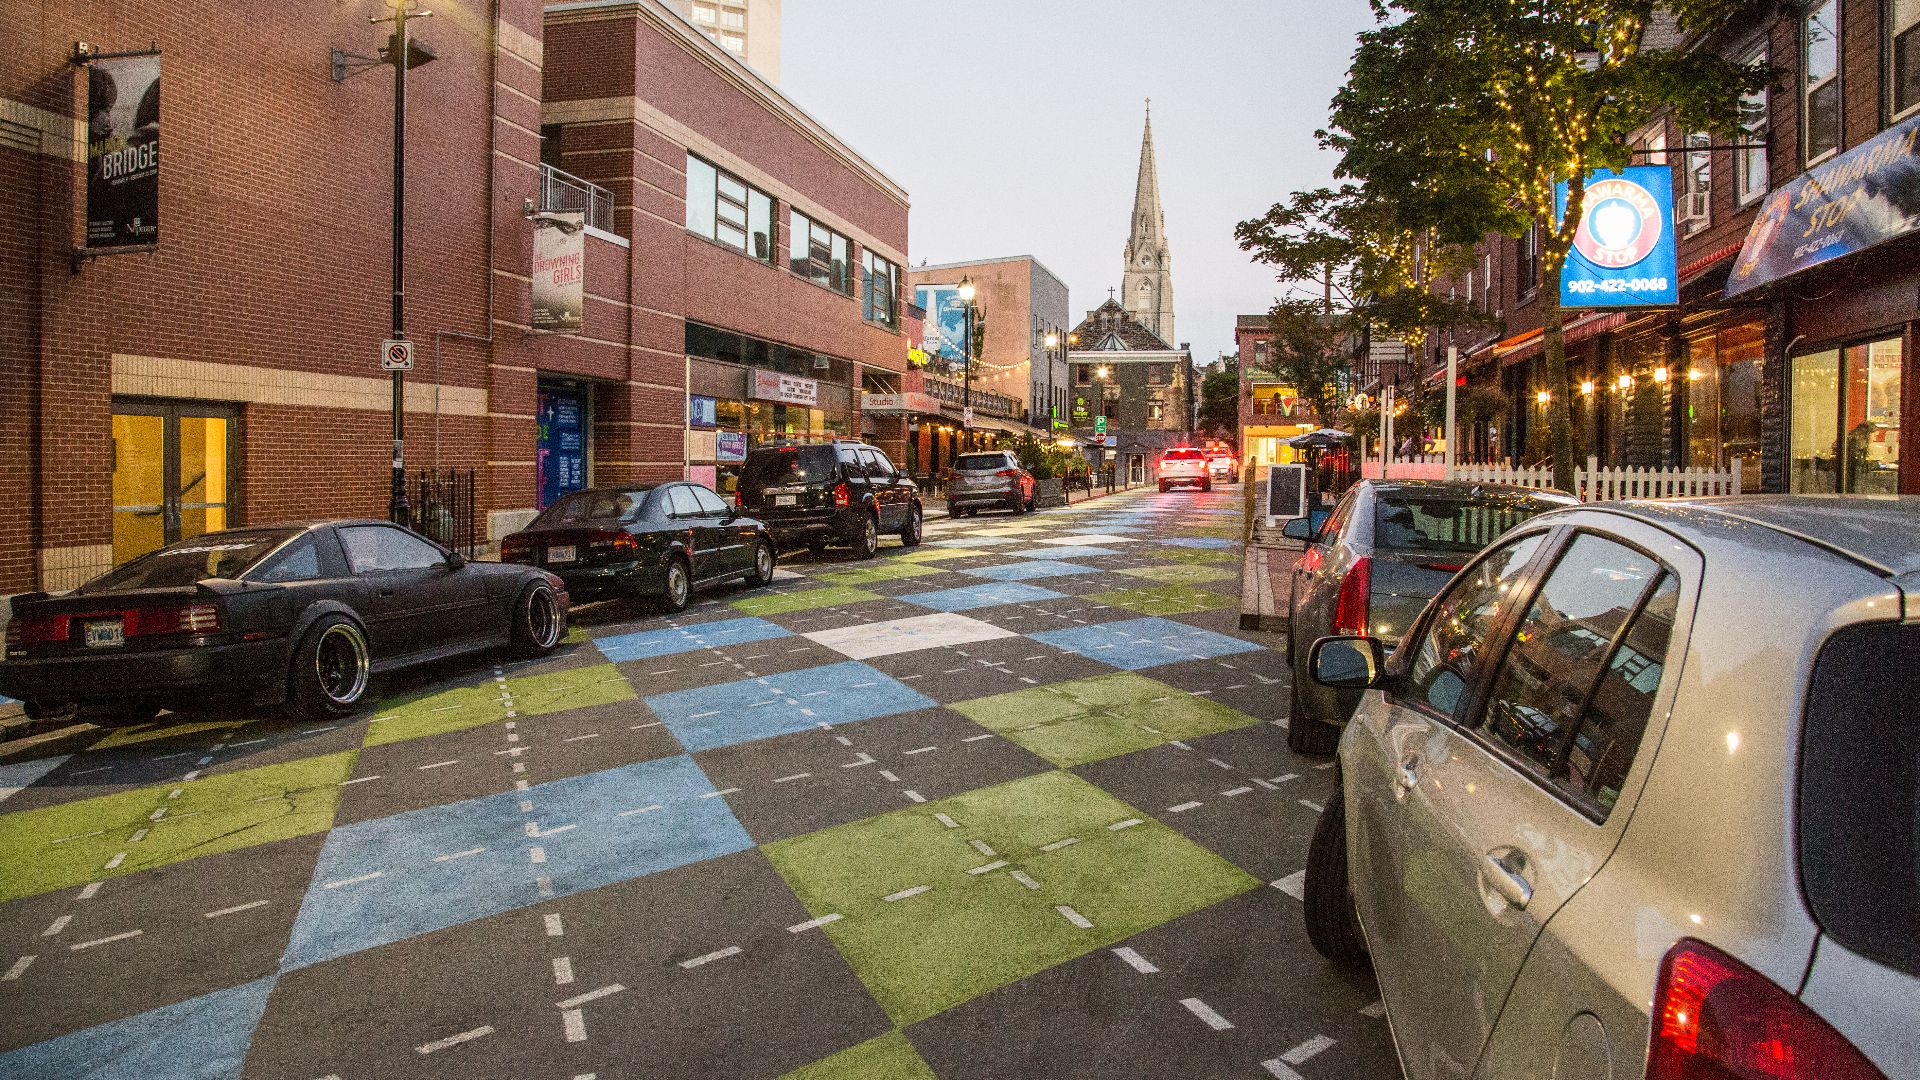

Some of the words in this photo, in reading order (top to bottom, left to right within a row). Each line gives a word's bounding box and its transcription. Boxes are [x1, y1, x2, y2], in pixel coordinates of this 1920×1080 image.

[103, 141, 157, 180] BRIDGE
[1795, 127, 1918, 210] SHAWARMA
[1802, 194, 1856, 238] STOP
[534, 252, 580, 274] DROWNING
[1594, 247, 1638, 264] STOP
[553, 264, 582, 285] GIRLS
[1568, 277, 1668, 293] 902-422-0068
[869, 397, 894, 406] Studio
[1097, 417, 1104, 425] P
